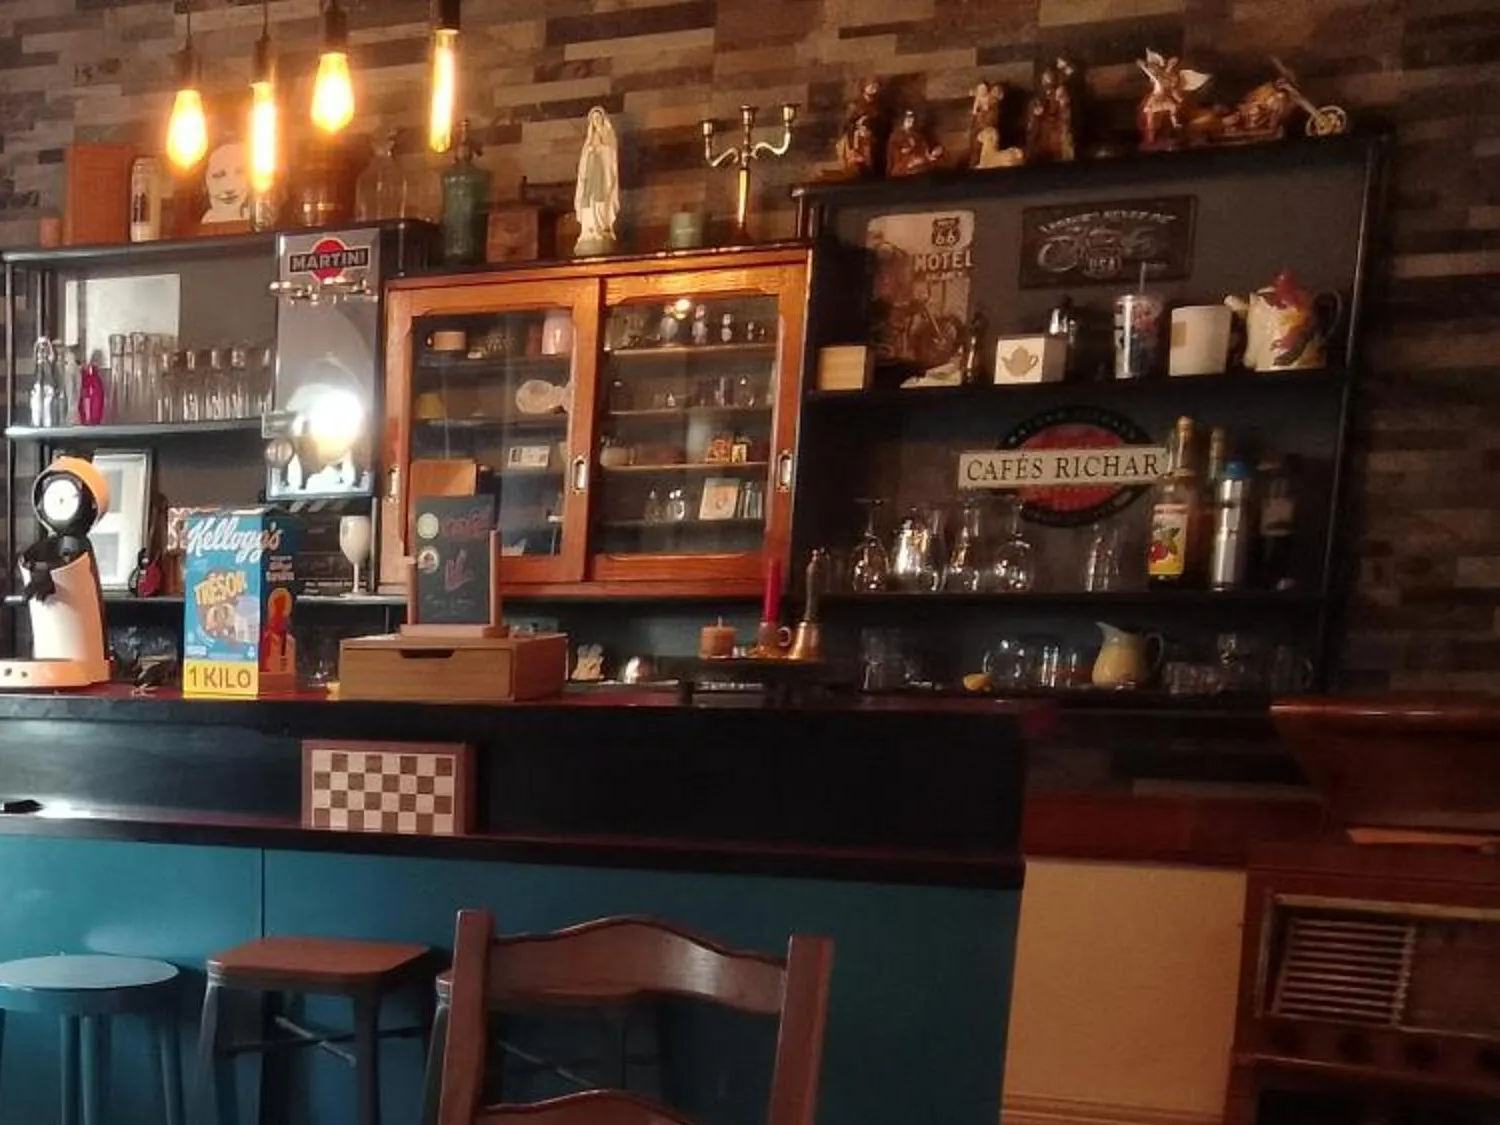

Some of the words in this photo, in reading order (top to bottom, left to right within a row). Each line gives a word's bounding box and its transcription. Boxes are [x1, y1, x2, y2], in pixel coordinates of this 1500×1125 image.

[935, 229, 957, 246] 66
[291, 251, 366, 271] MARTINI
[914, 248, 974, 272] MOTEL
[966, 453, 1044, 481] CAFÉS
[1055, 453, 1168, 479] RICHAR
[186, 515, 282, 563] Kellogg's
[189, 668, 197, 688] 1
[203, 666, 251, 689] KILO
